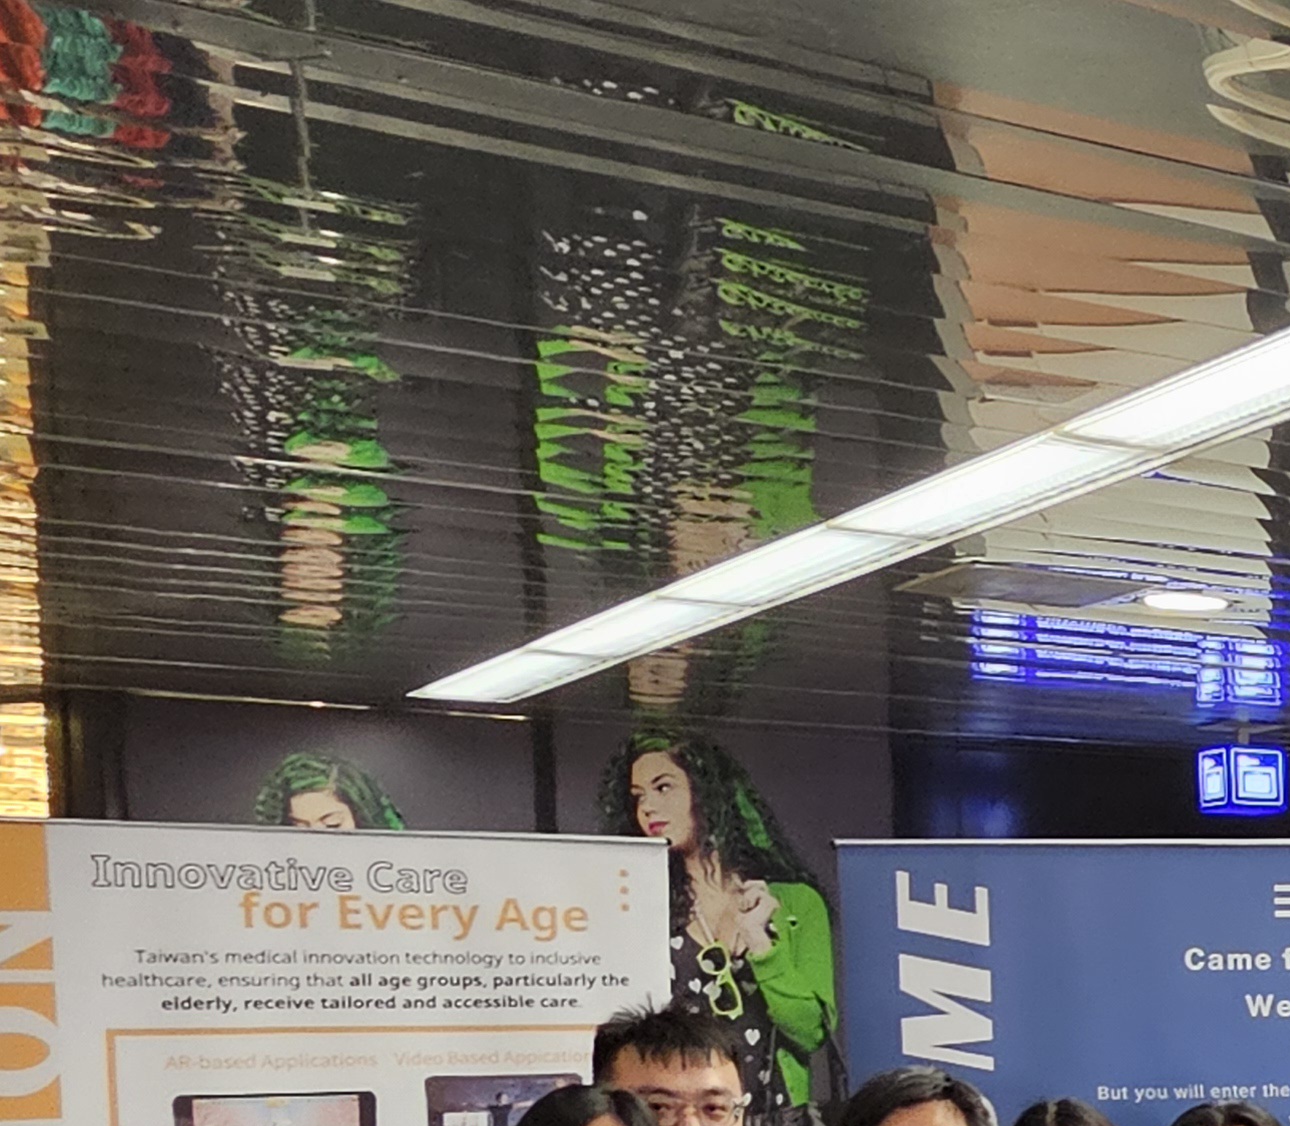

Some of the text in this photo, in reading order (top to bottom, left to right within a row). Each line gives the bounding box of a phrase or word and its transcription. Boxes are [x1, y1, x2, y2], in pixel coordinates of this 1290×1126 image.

[91, 855, 468, 894] Innovative Care
[239, 892, 589, 942] for Every Age
[135, 949, 601, 968] Taiwan's medical innovation technology to inclusive
[1185, 947, 1271, 970] Came
[102, 973, 629, 991] healthcare, ensuring that all age groups, particularly the
[162, 996, 237, 1014] elderly,
[244, 997, 314, 1010] receive
[321, 995, 396, 1009] tailored
[402, 996, 436, 1009] and
[442, 995, 534, 1008] accessible
[261, 1053, 377, 1072] Applications
[395, 1052, 443, 1067] Video
[1097, 1084, 1290, 1103] But you will enter the
